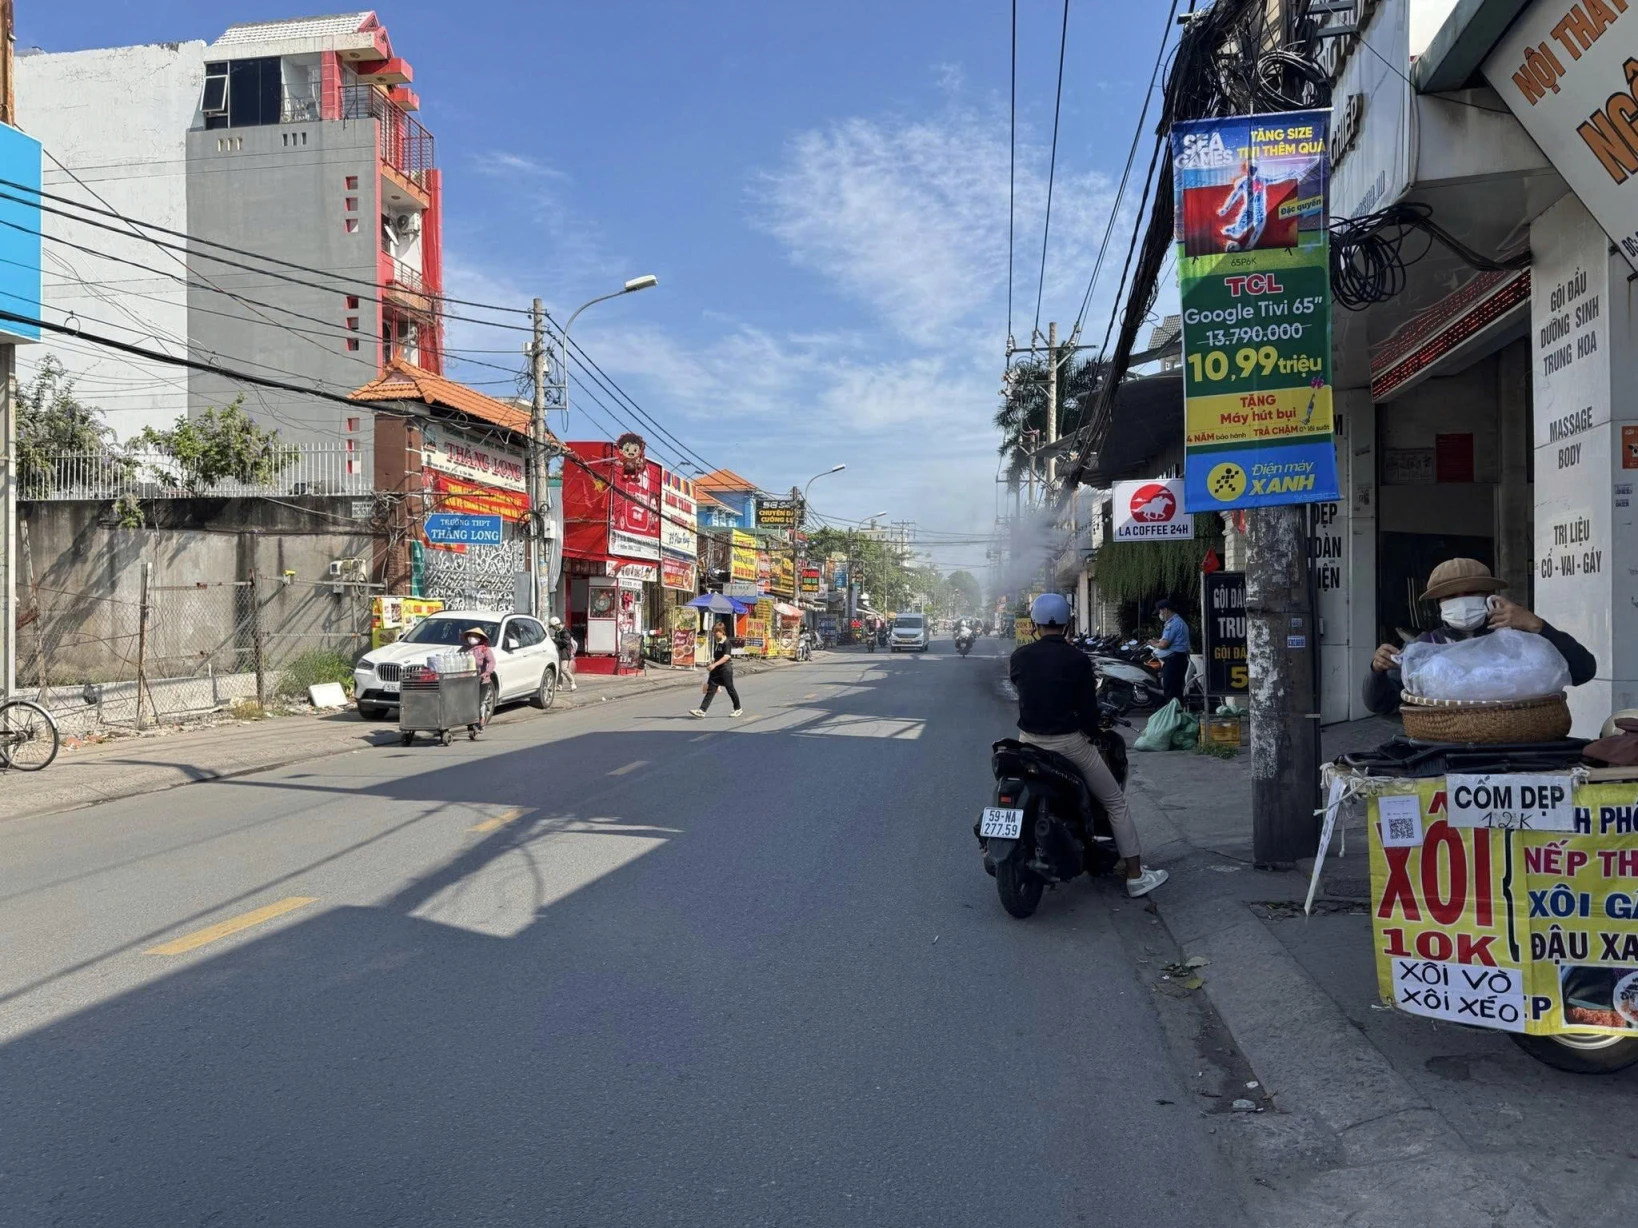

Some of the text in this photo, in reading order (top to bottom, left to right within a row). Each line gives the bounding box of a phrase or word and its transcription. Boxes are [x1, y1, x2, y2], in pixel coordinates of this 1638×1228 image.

[1511, 41, 1566, 106] NỘI
[1184, 132, 1225, 151] SEA
[1251, 126, 1313, 142] TĂNG SIZE
[1175, 149, 1233, 168] GAMES
[1263, 141, 1296, 156] THÊM
[1231, 257, 1257, 267] 65P6K
[1224, 273, 1284, 297] TCL
[1550, 267, 1587, 313] GỘI ĐẦU
[1184, 304, 1254, 325] Google
[1258, 300, 1288, 317] Tivi
[1576, 295, 1600, 326] SINH
[1206, 322, 1303, 346] 13.790.000
[1187, 345, 1322, 382] 10,99 triệu
[1543, 330, 1598, 377] TRUNG HOA
[1240, 393, 1277, 411] TẶNG
[1220, 406, 1297, 425] Máy hút bụi
[1549, 406, 1593, 443] MASSAGE
[1194, 431, 1215, 442] NĂM
[1272, 425, 1299, 436] CHẬM
[444, 441, 491, 470] THĂNG
[492, 458, 523, 481] LONG
[1558, 442, 1582, 470] BODY
[1251, 460, 1314, 478] Điện máy
[1248, 474, 1316, 496] XANH
[431, 526, 500, 541] THĂNG LONG
[472, 519, 491, 527] THPT
[1119, 523, 1189, 537] LA COFFEE 24H
[1553, 516, 1590, 548] TRỊ LIỆU
[1561, 554, 1575, 577] VAI
[1582, 546, 1602, 575] GÁY
[1317, 563, 1340, 592] IỆN
[1213, 584, 1229, 613] GỘI
[1214, 644, 1231, 662] GỘI
[1454, 776, 1565, 817] CỐM DẸP
[988, 810, 1017, 824] 59-NA
[984, 823, 1018, 837] 277.59
[1524, 840, 1588, 877] NẾP
[1529, 883, 1591, 918] XÔI
[1382, 928, 1498, 968] 10K
[1531, 924, 1589, 964] ĐẬU
[1461, 969, 1512, 994] VÒ
[1457, 995, 1519, 1023] XÉO
